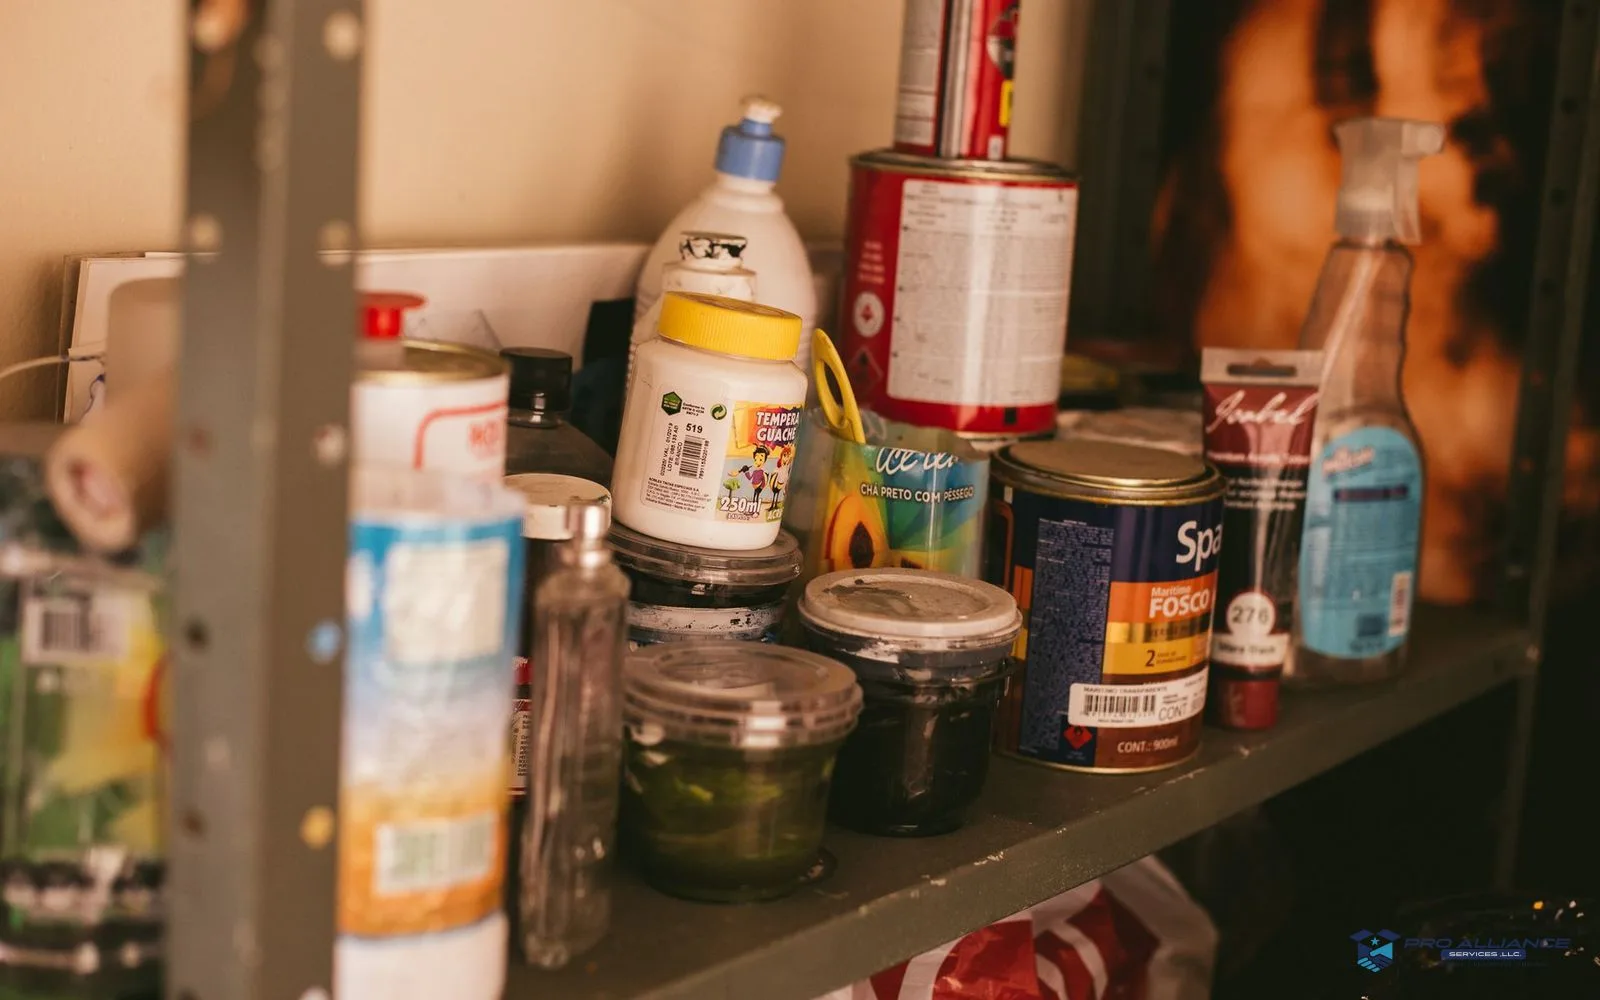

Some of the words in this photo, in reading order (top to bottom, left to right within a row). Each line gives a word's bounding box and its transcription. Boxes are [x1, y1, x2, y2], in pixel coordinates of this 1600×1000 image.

[686, 423, 703, 433] 519
[756, 411, 799, 427] TEMPERA
[756, 427, 796, 441] GUACHE
[860, 483, 878, 496] CHÁ
[881, 487, 912, 500] PRETO
[915, 491, 940, 503] COM
[720, 496, 762, 514] 250ml
[1176, 520, 1222, 572] Spa
[1149, 589, 1210, 618] FOSCO
[1232, 605, 1269, 625] 276
[1145, 650, 1155, 667] 2
